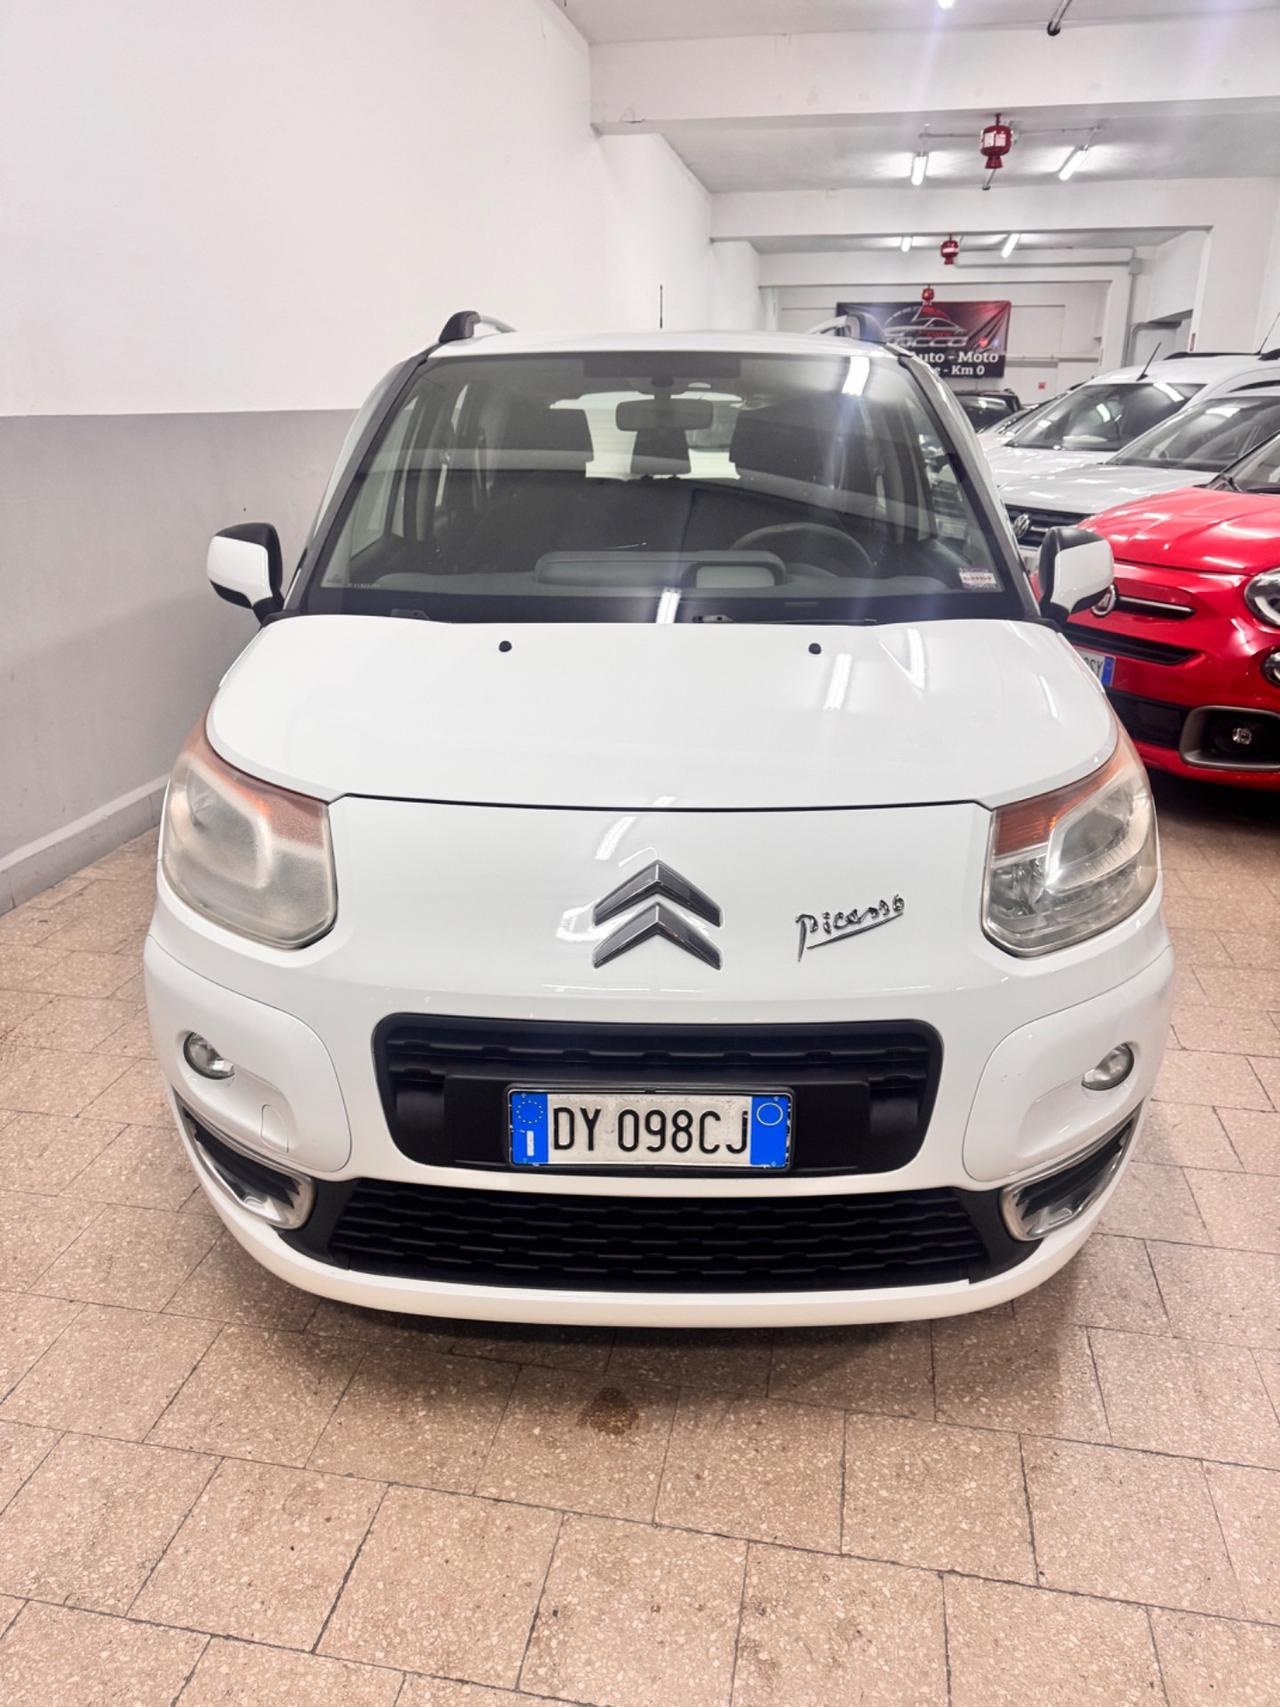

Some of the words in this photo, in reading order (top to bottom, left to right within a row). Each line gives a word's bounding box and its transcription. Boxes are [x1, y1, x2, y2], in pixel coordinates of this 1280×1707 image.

[958, 351, 999, 363] Moto
[951, 365, 974, 375] Km
[553, 1107, 601, 1151] DY
[617, 1109, 749, 1154] 098CJ
